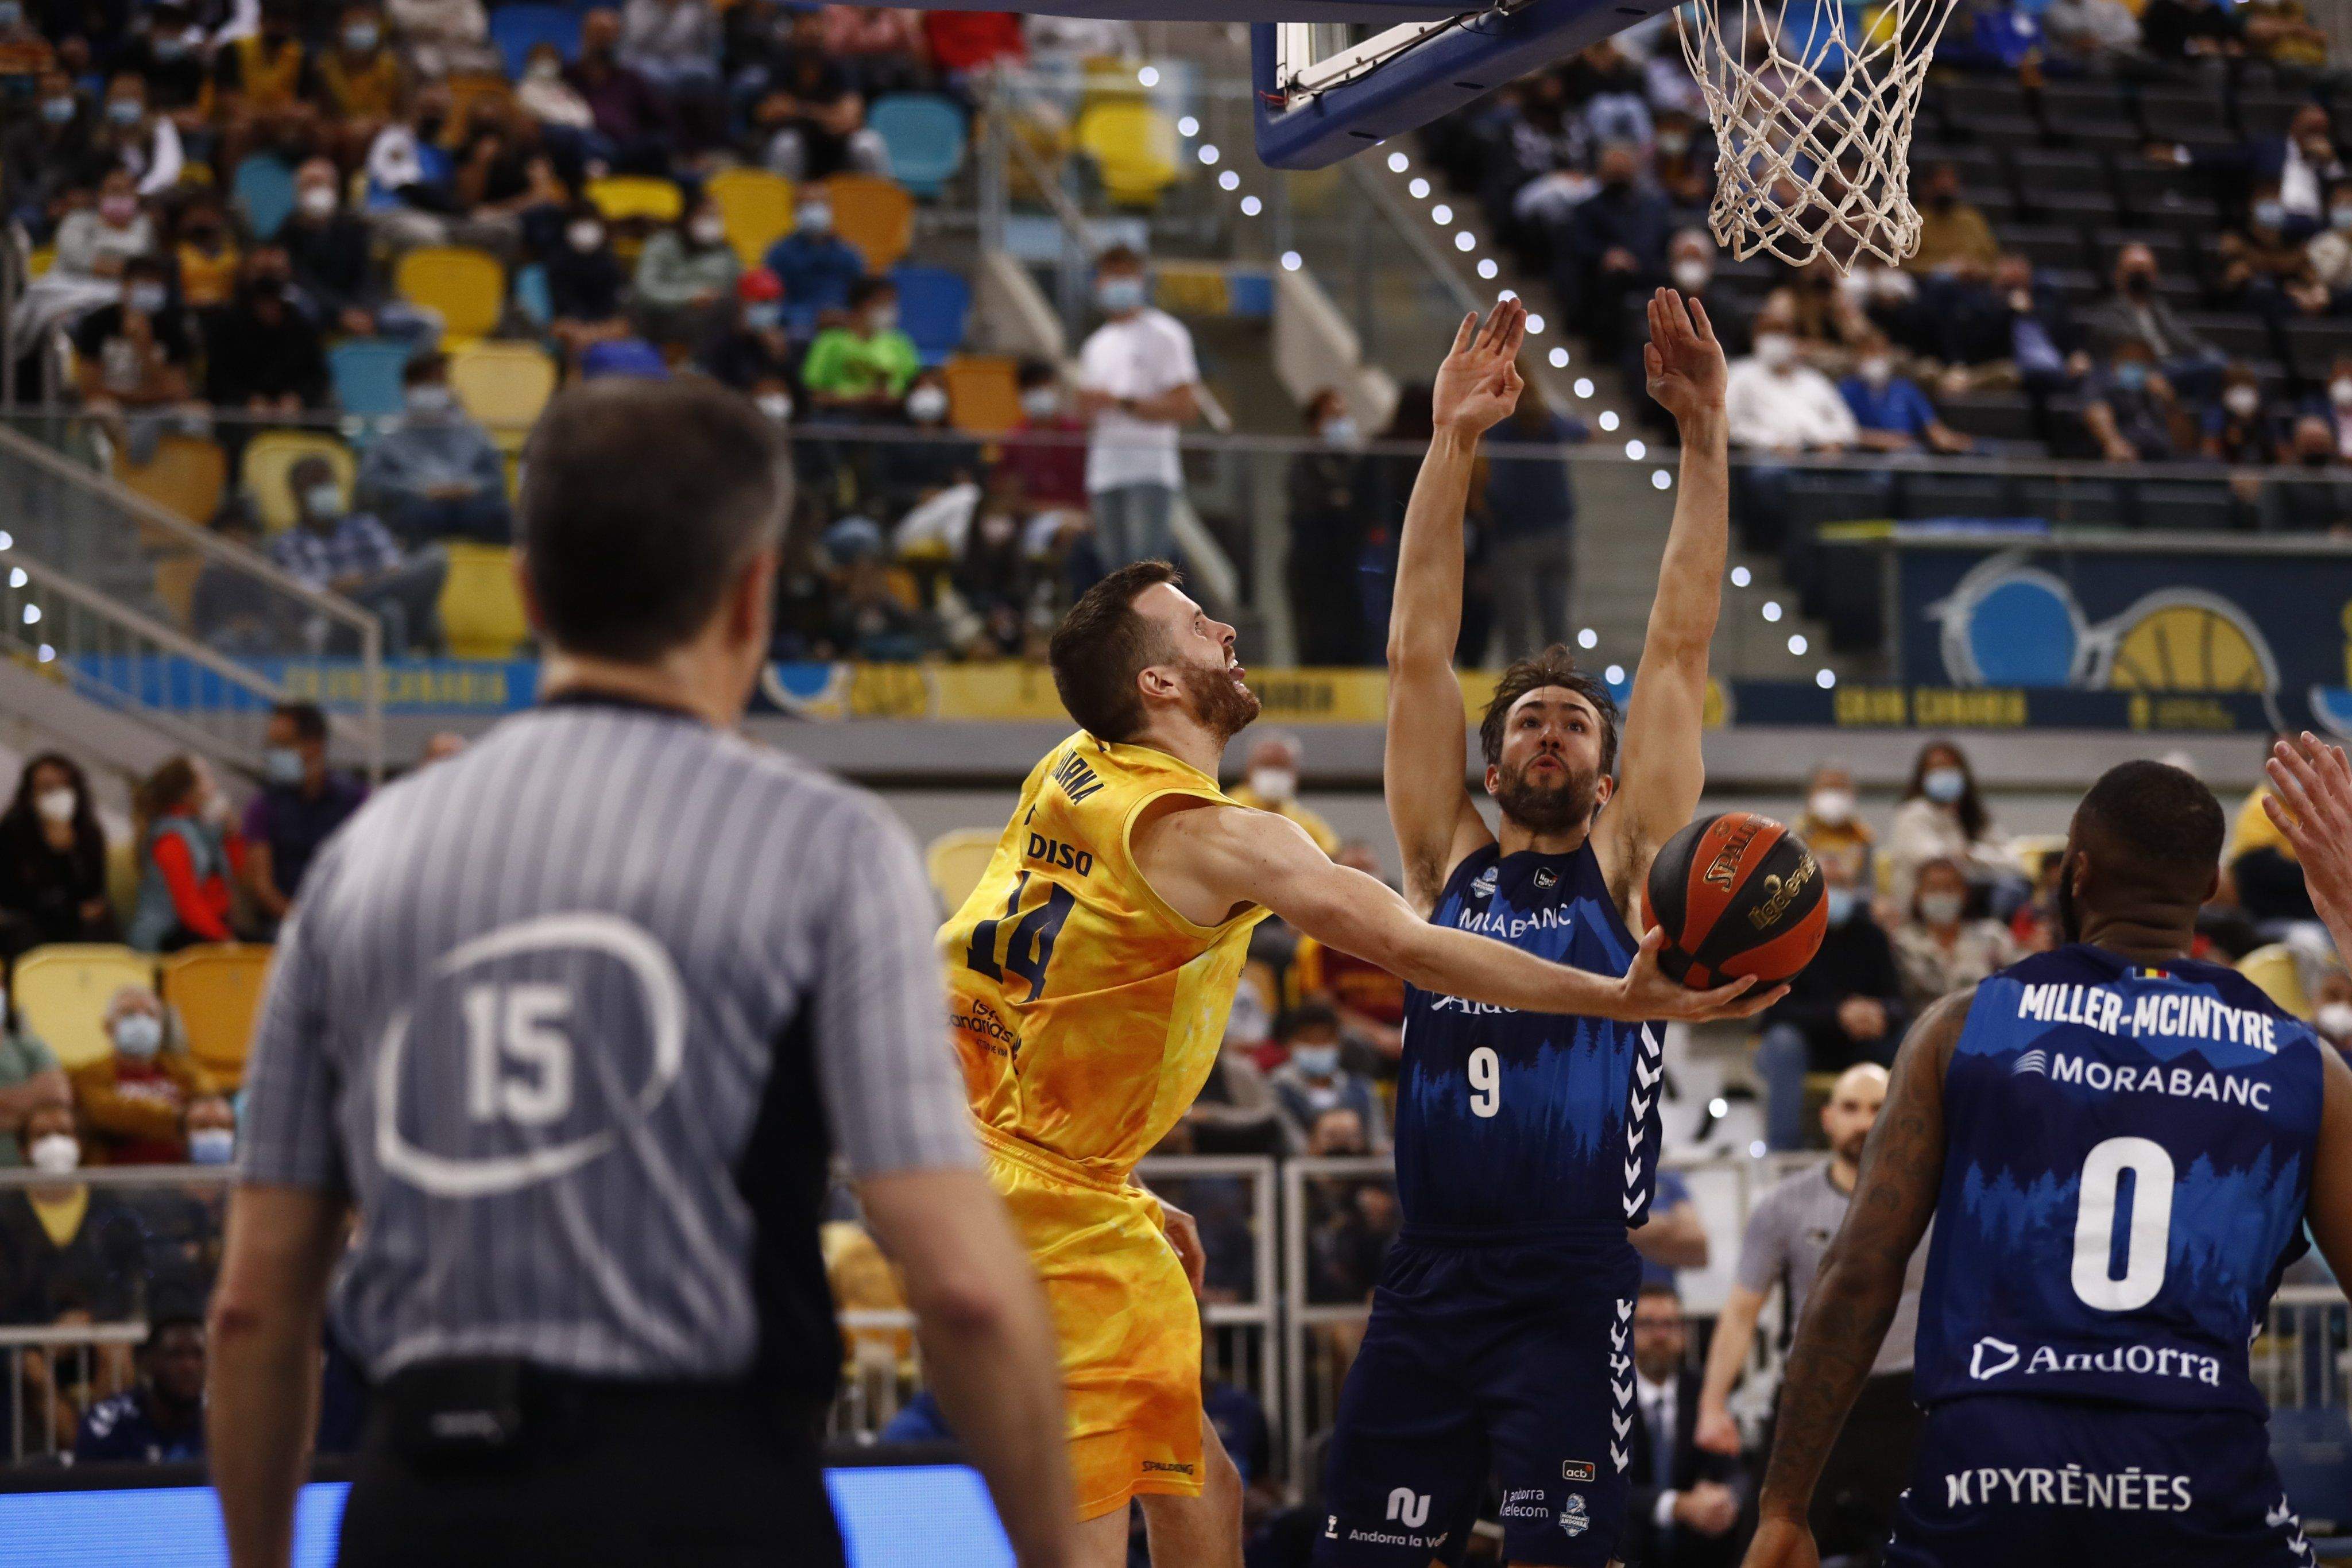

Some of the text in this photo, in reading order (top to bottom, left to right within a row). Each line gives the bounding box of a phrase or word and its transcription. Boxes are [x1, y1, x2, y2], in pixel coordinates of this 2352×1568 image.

[966, 870, 1076, 1005] 14
[949, 1014, 1013, 1043] anarias
[2017, 983, 2278, 1055] MILLER-MCINTYRE
[466, 981, 573, 1124] 15
[1468, 1047, 1500, 1117] 9
[2051, 1053, 2272, 1112] MORABANC
[2024, 1345, 2220, 1387] Andorra
[1142, 1461, 1194, 1476] SPALDING
[1566, 1469, 1587, 1478] acb
[1510, 1488, 1544, 1502] andorra
[1349, 1528, 1406, 1546] Andorra
[1409, 1535, 1422, 1547] la
